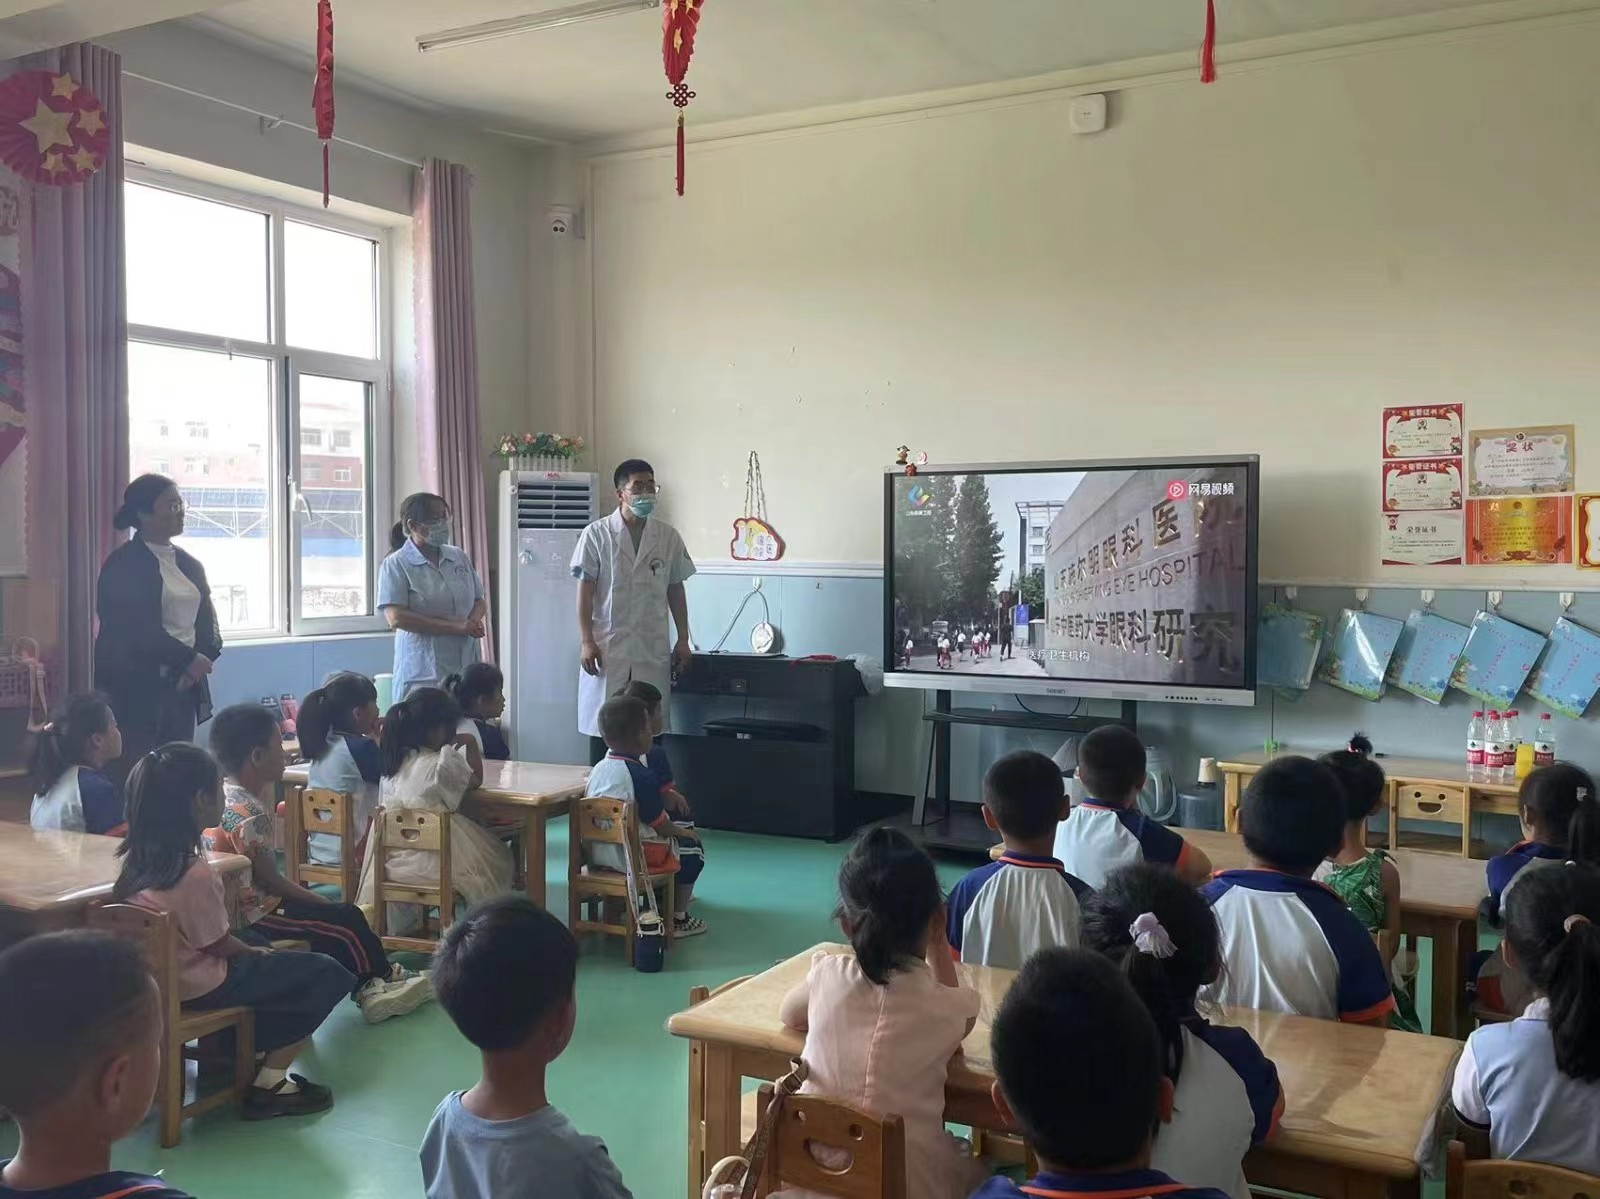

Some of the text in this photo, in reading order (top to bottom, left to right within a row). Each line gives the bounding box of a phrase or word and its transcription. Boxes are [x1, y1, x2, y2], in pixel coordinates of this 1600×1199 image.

[1188, 482, 1234, 496] 网易视频
[1407, 525, 1437, 533] 荣誉证书
[1139, 536, 1245, 588] HOSPITAL
[1028, 649, 1090, 663] 医疗卫生机构
